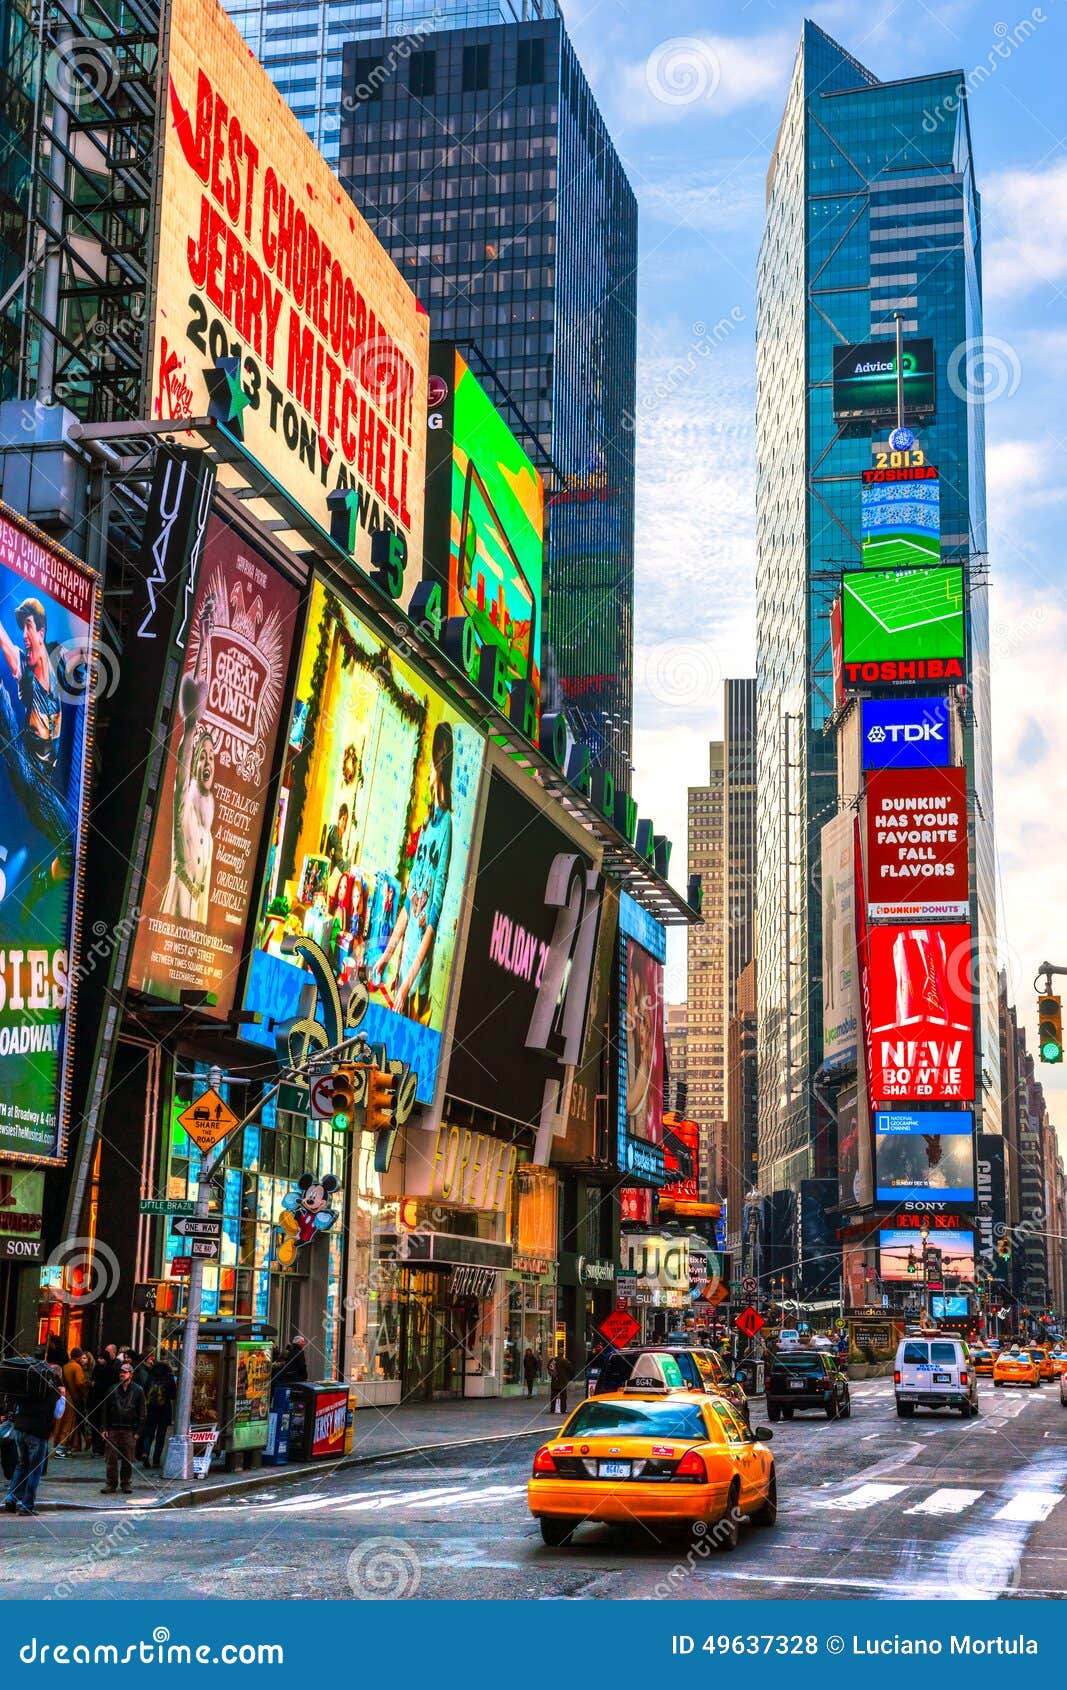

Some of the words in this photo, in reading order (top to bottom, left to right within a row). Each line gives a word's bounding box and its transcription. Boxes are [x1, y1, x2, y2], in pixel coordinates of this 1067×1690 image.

[188, 67, 259, 240] BEST
[187, 193, 283, 370] JERRY
[287, 307, 411, 531] MITCHELL
[855, 361, 894, 373] Advice
[266, 376, 334, 488] TONY
[876, 450, 925, 469] 2013
[863, 466, 939, 483] TOSHIBA
[21, 536, 91, 600] CHOREOGRAPHY
[41, 572, 83, 612] WINNER!
[216, 652, 258, 699] GREAT
[845, 659, 962, 682] TOSHIBA
[209, 677, 257, 727] COMET
[885, 723, 944, 741] TDK
[231, 792, 251, 814] TALK
[882, 796, 952, 811] DUNKIN'
[218, 804, 234, 824] THE
[875, 814, 909, 828] HAS
[913, 812, 959, 827] YOUR
[877, 829, 957, 845] FAVORITE
[898, 847, 936, 860] FALL
[880, 862, 955, 878] FLAVORS
[216, 871, 248, 895] ORIGINAL
[490, 910, 538, 982] HOLIDAY
[535, 941, 550, 989] 2
[881, 1040, 962, 1068] NEW
[882, 1084, 933, 1095] SHAED
[7, 1106, 14, 1117] at
[14, 1104, 40, 1125] Broadway
[195, 1121, 220, 1130] SHARE
[197, 1136, 216, 1144] ROAD
[429, 1121, 518, 1212] FOREVER
[977, 1160, 992, 1201] CALL
[140, 1201, 163, 1210] LITTLE
[167, 1202, 194, 1210] BRAZIL
[905, 1201, 947, 1210] SONY
[185, 1223, 199, 1232] ONE
[202, 1224, 217, 1233] WAY
[896, 1214, 930, 1228] DEVILS
[935, 1215, 960, 1228] BEAT
[7, 1240, 41, 1257] SONY
